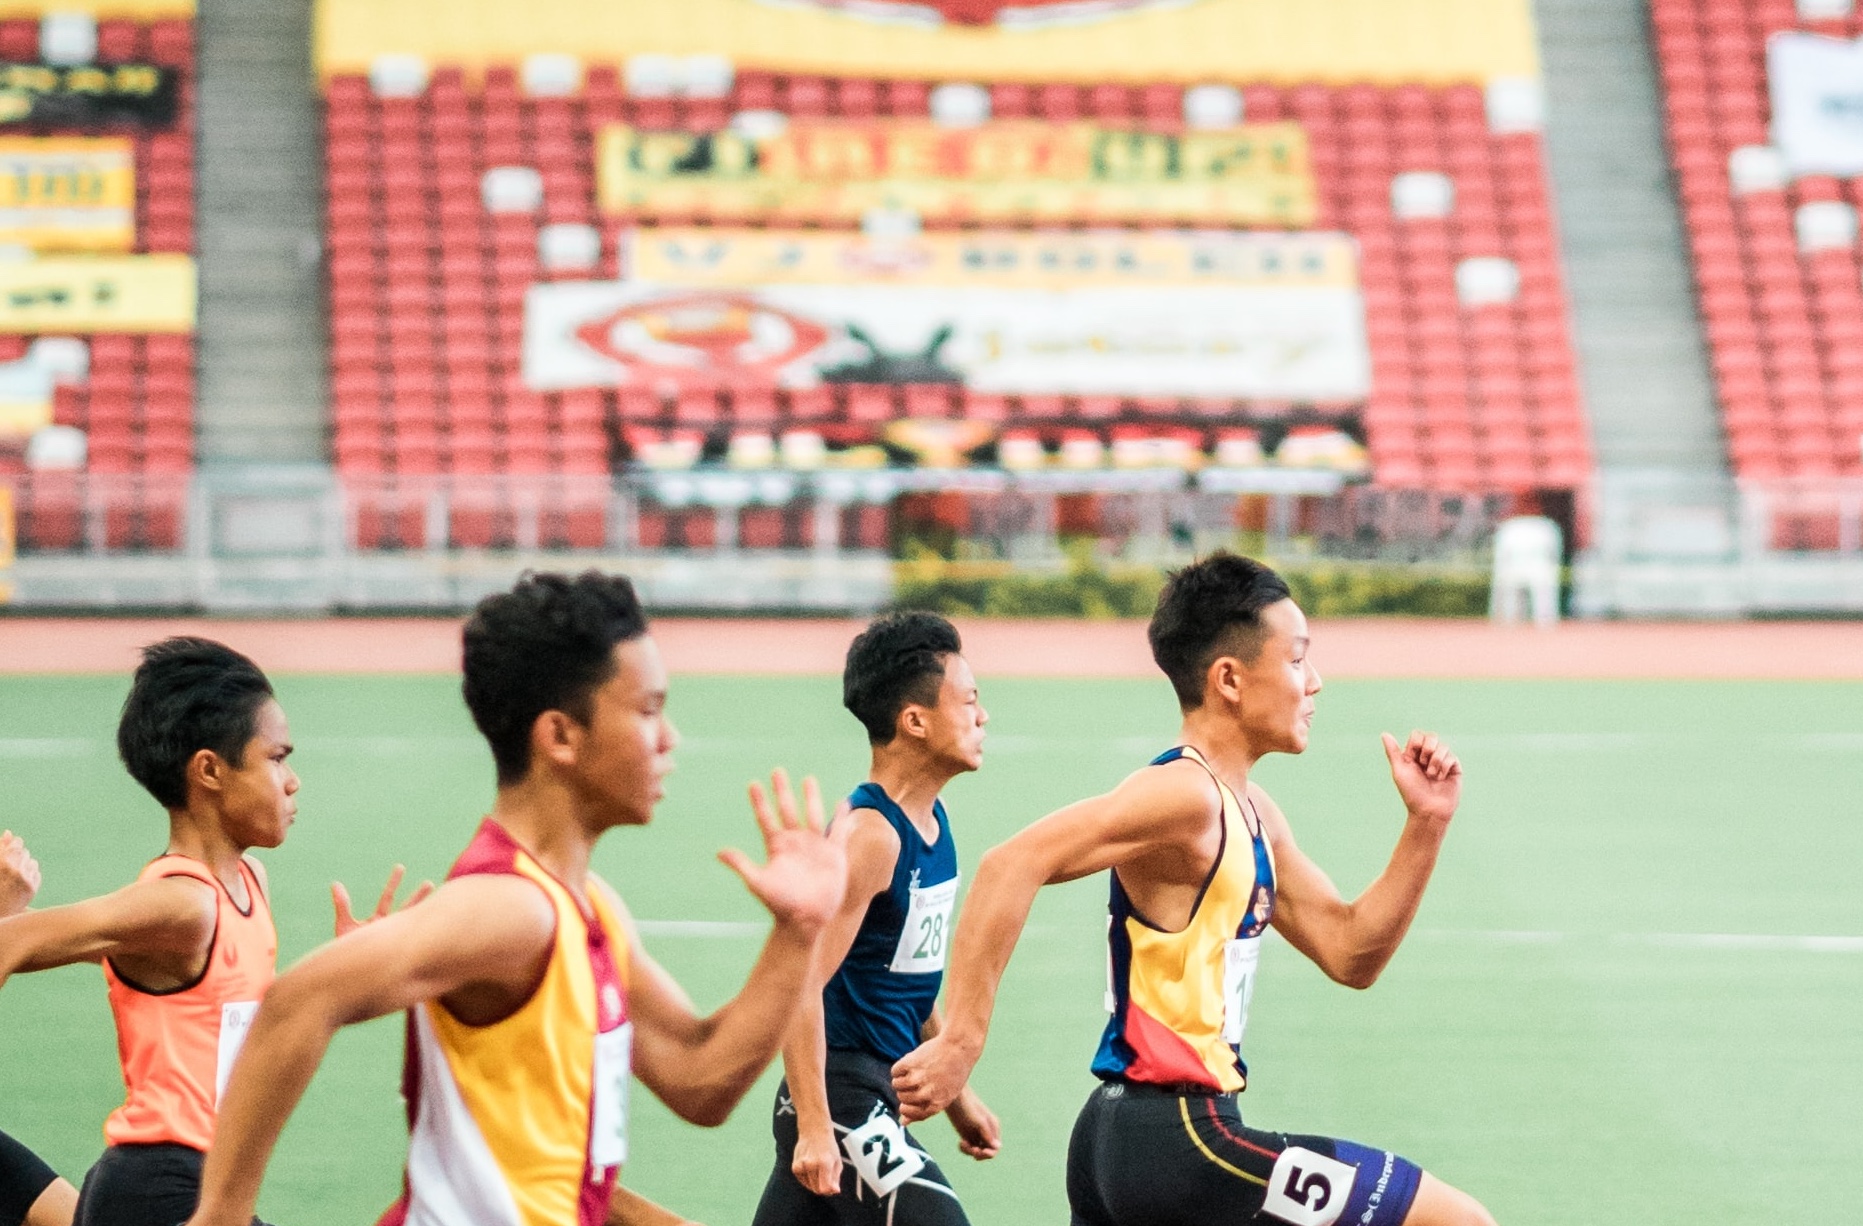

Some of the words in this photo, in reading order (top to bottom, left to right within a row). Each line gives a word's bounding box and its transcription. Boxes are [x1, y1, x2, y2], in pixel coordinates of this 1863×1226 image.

[911, 912, 949, 959] 28
[862, 1134, 905, 1180] 2
[1283, 1165, 1332, 1212] 5
